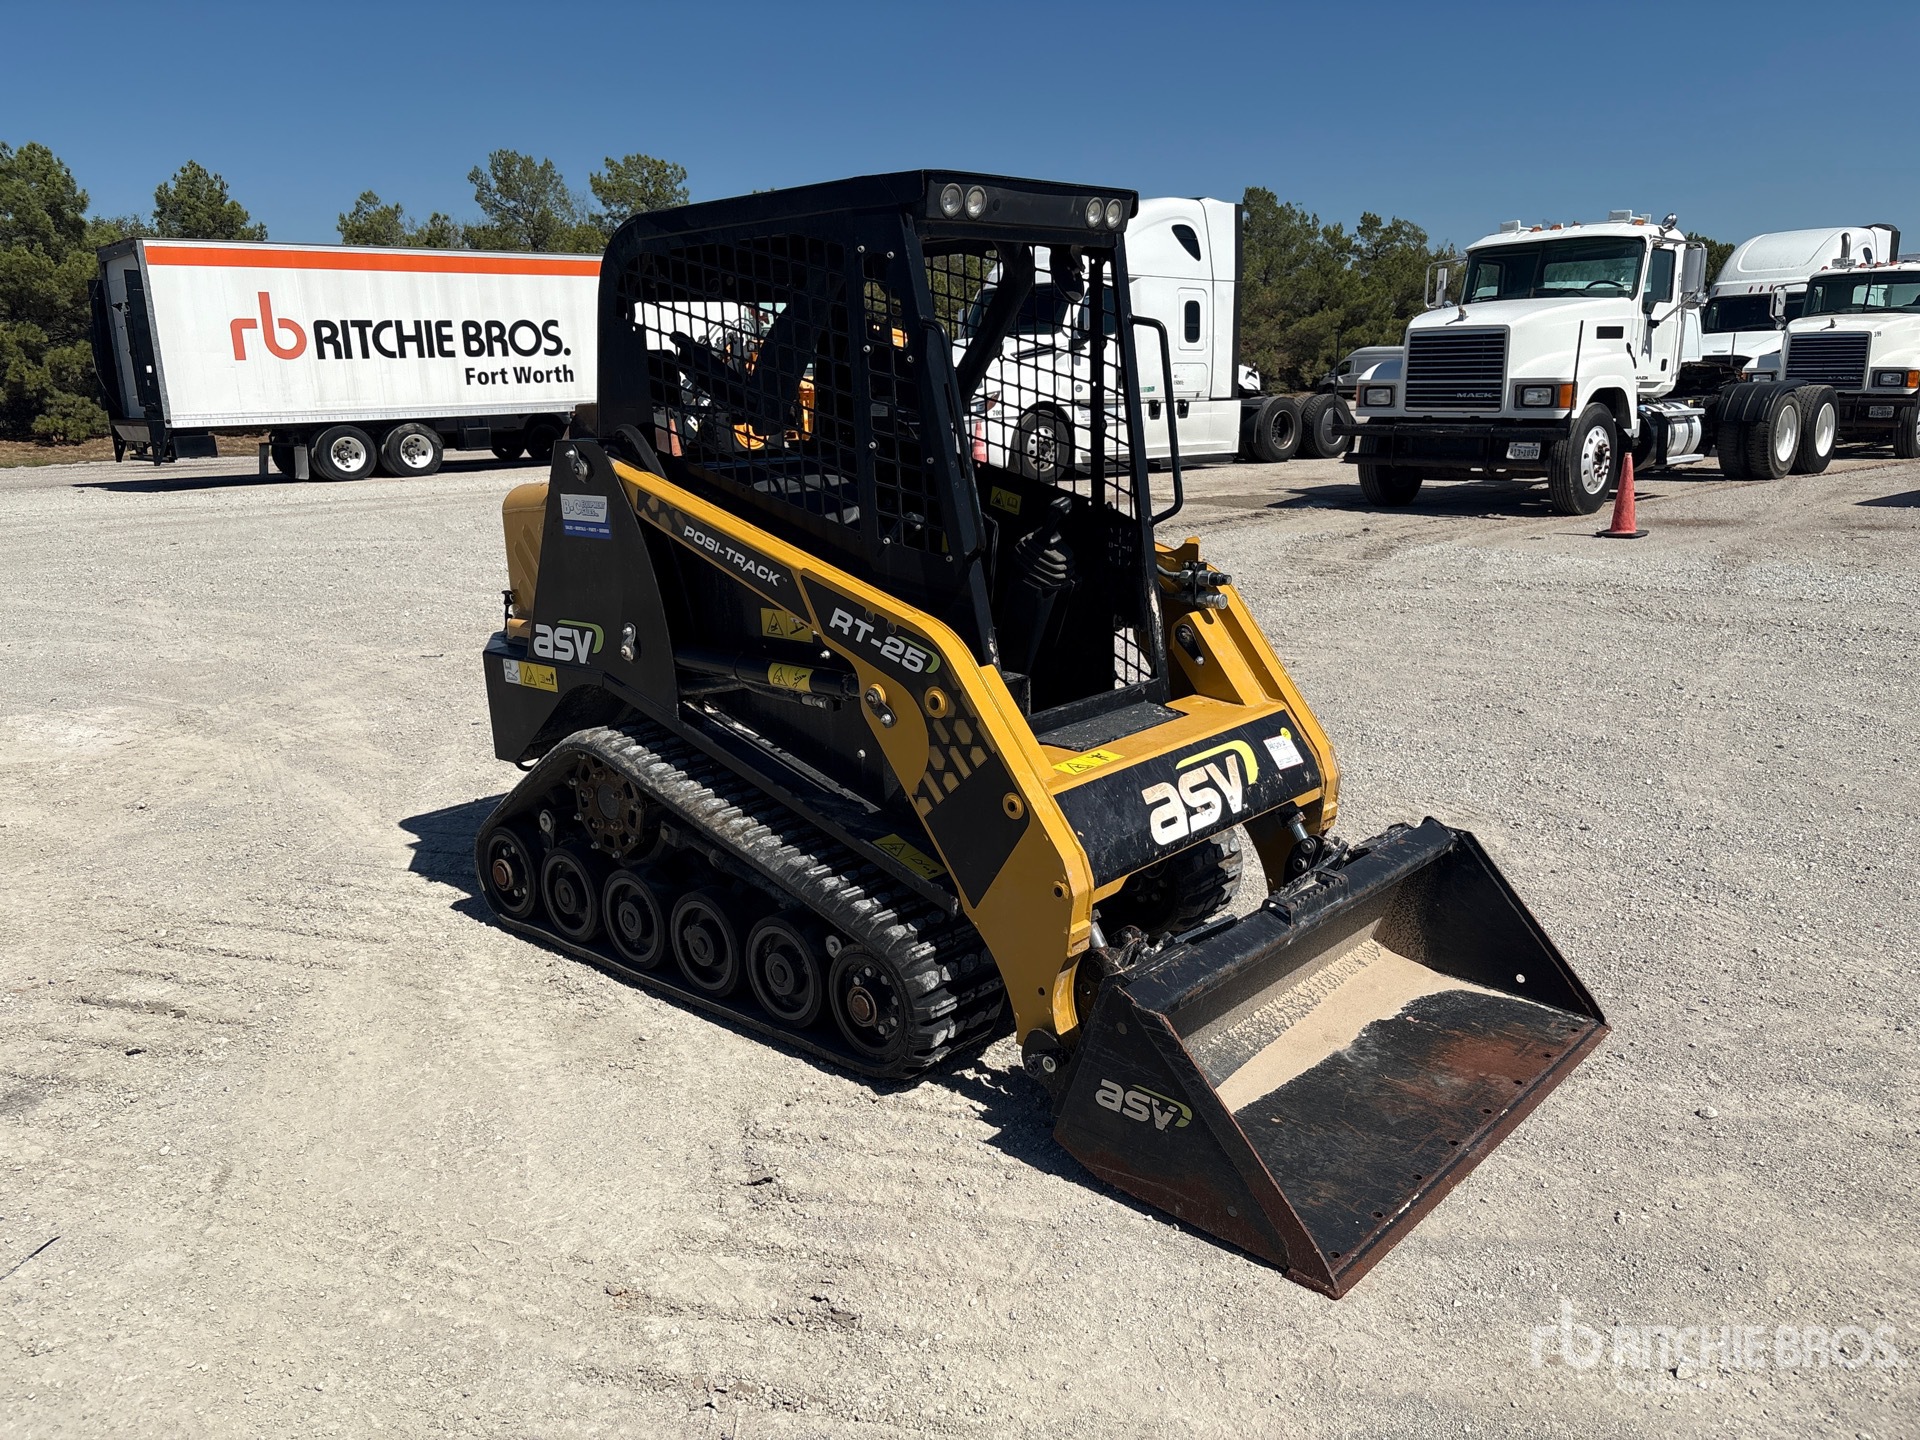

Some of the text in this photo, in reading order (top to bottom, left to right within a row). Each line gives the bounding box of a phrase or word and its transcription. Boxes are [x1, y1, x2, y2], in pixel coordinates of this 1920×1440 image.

[313, 319, 456, 360] RITCHIE
[461, 319, 572, 358] BROS.
[465, 364, 575, 386] Fort Worth
[683, 525, 781, 588] POSI-TRACK
[828, 606, 928, 674] RT-25
